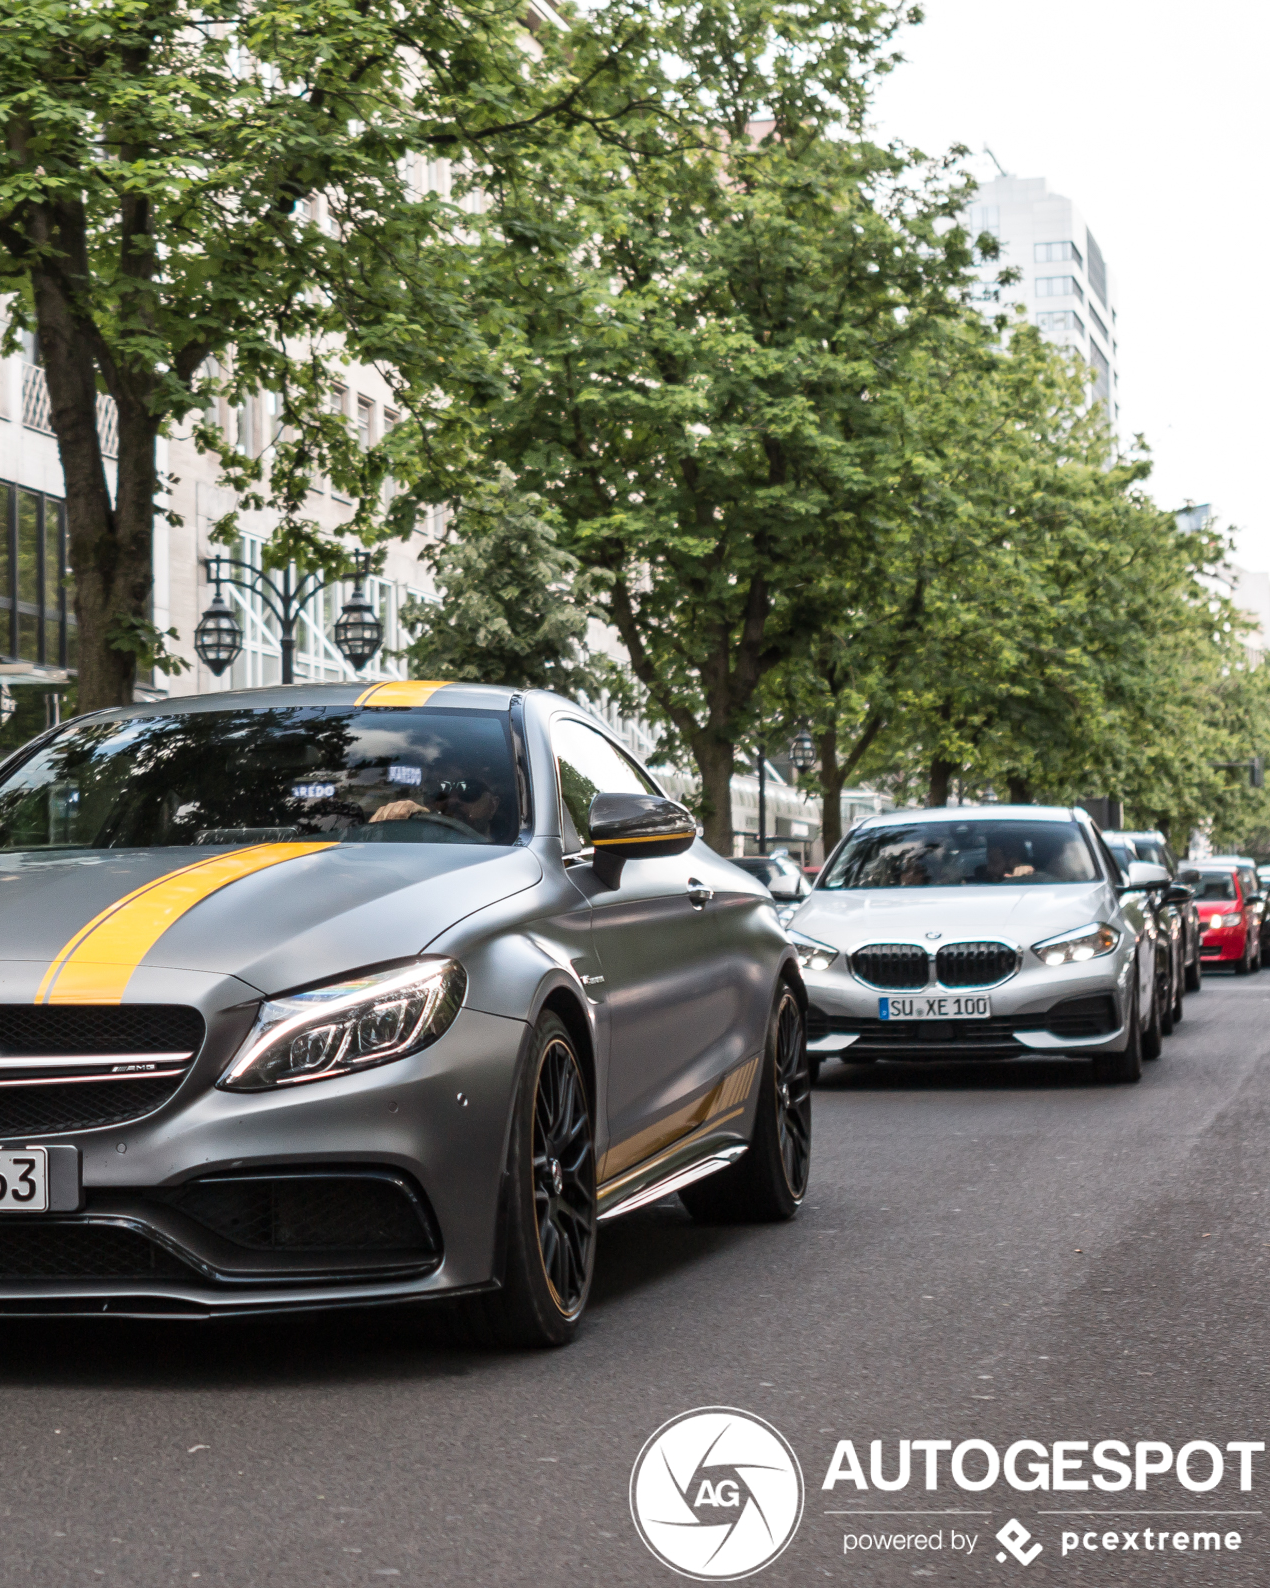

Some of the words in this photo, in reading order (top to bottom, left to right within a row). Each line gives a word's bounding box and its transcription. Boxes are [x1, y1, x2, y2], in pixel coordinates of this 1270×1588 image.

[890, 999, 914, 1017] SU
[926, 999, 950, 1016] XE
[952, 997, 987, 1016] 100
